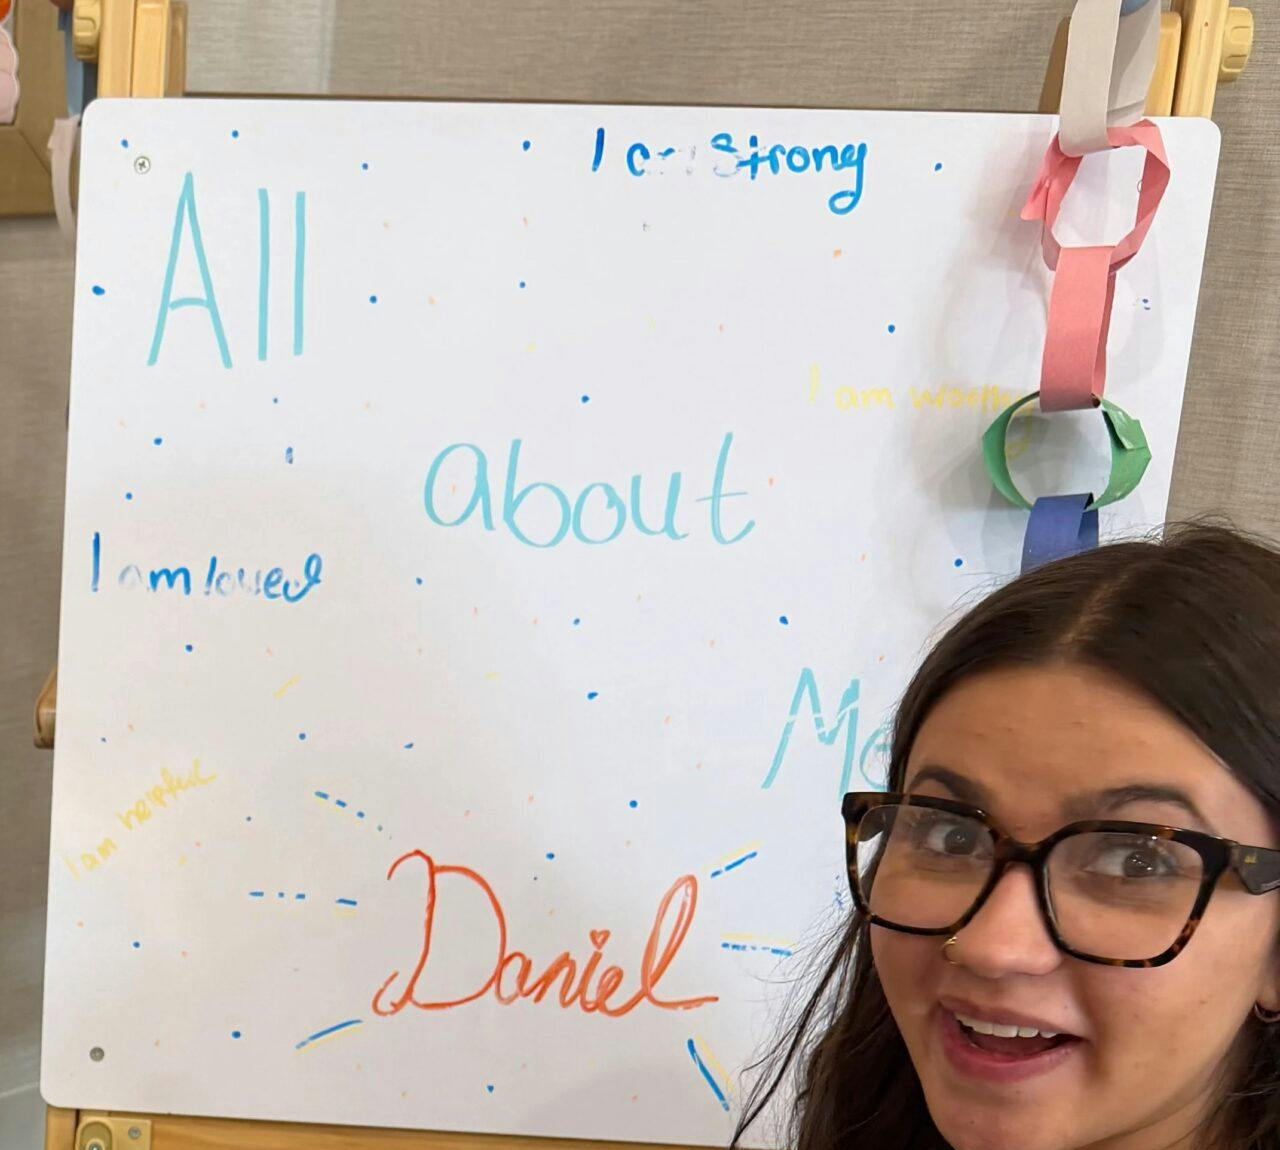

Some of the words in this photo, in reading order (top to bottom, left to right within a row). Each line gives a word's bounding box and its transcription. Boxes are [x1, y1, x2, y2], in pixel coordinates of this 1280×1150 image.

[591, 127, 605, 172] I
[147, 171, 306, 369] All
[833, 385, 895, 411] am
[424, 431, 756, 548] about
[91, 531, 101, 593] I
[118, 564, 192, 596] am
[204, 553, 322, 603] loved
[80, 837, 118, 872] am
[371, 848, 719, 1017] Daniel
